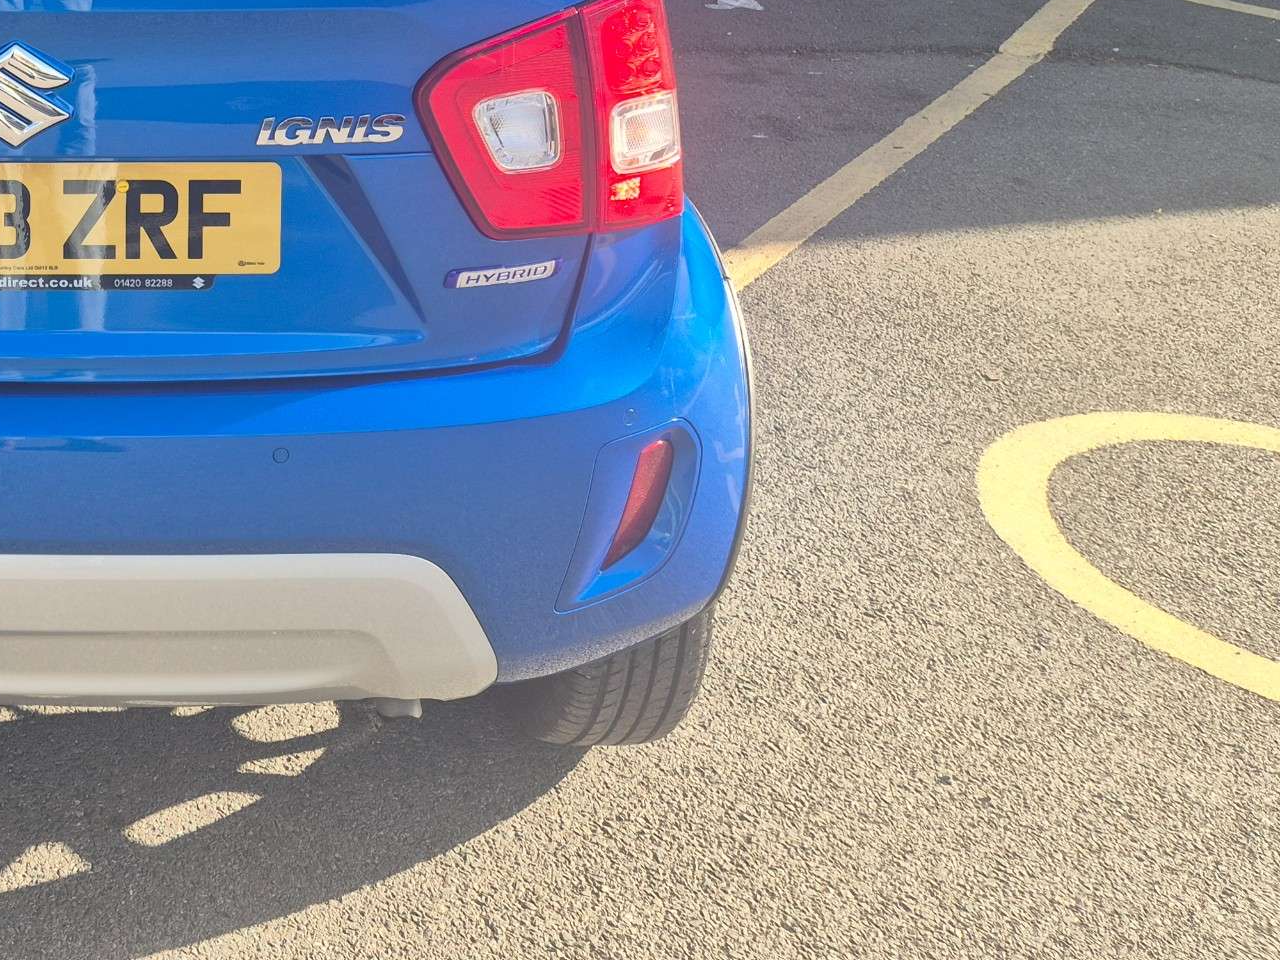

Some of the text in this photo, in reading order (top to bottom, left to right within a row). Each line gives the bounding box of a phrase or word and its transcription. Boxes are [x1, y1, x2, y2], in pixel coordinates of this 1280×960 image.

[256, 114, 406, 146] IGNIS
[62, 179, 242, 260] ZRF
[114, 278, 141, 288] 01420
[145, 279, 173, 288] 82288
[465, 265, 548, 285] HYBRID
